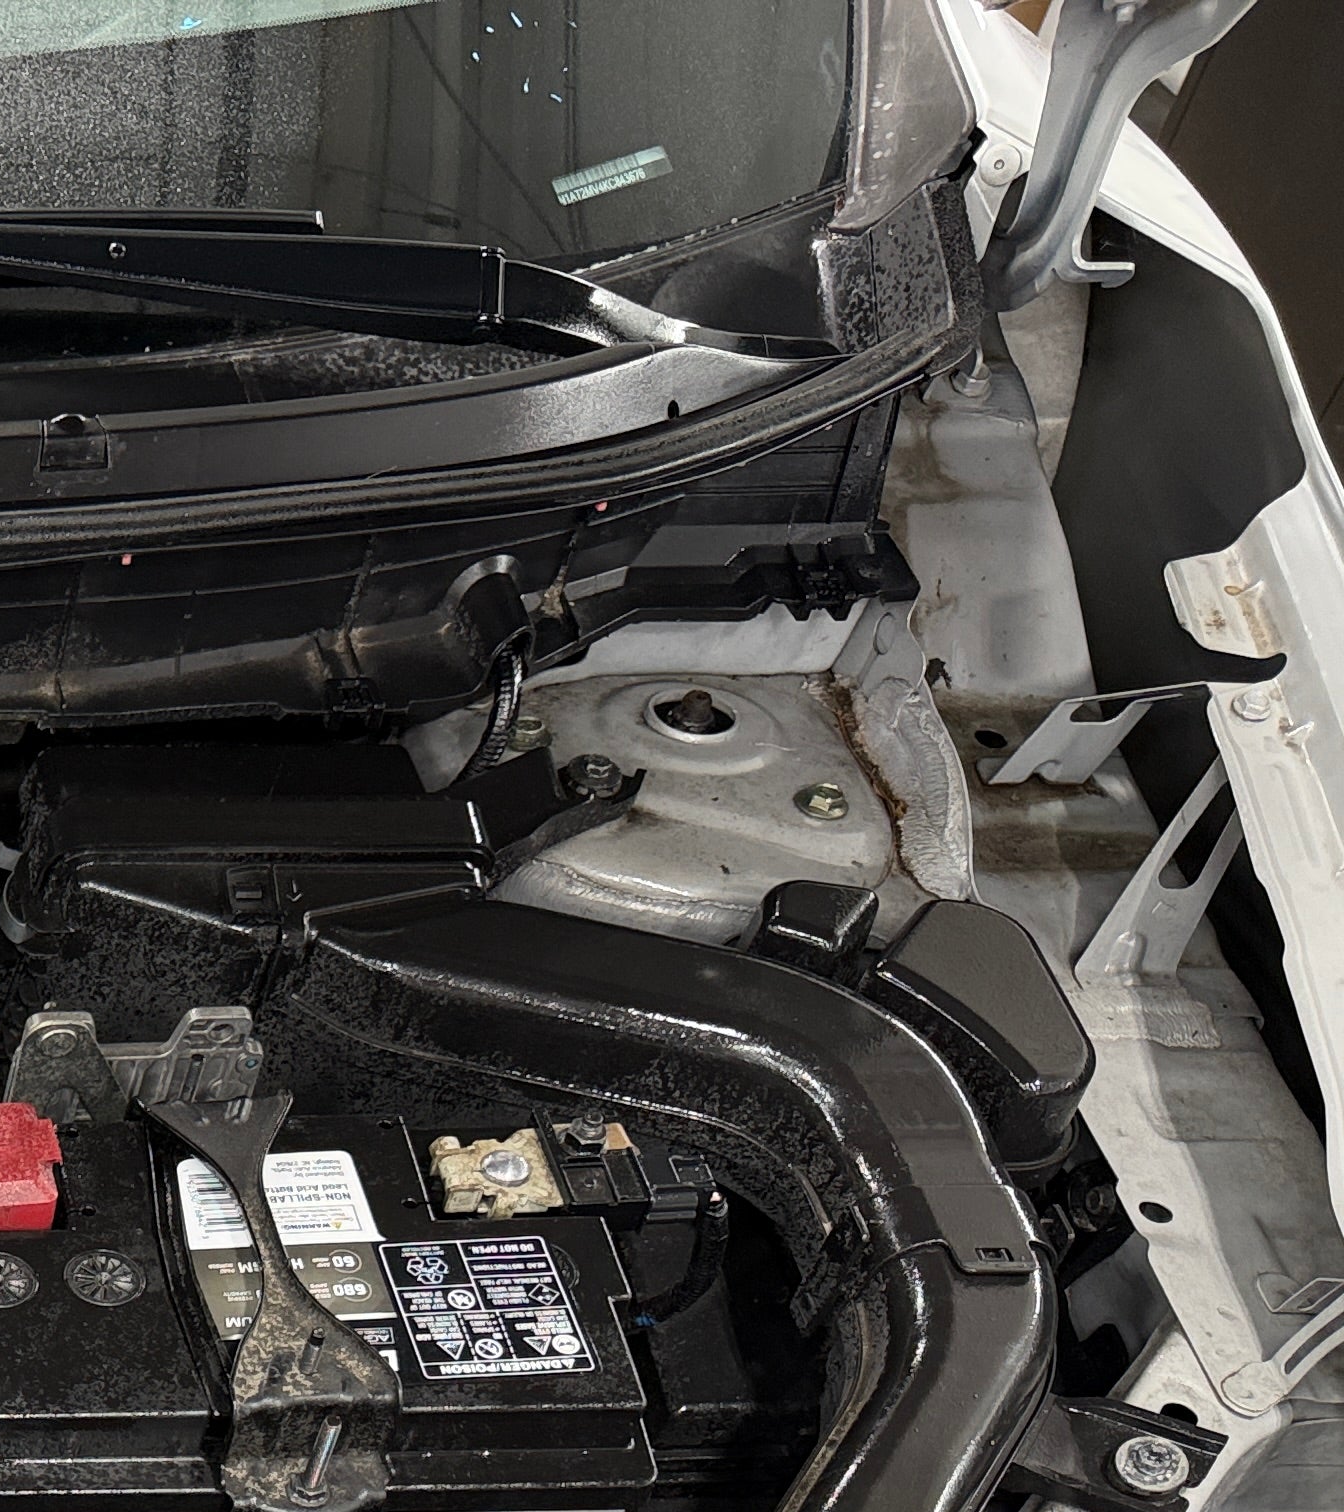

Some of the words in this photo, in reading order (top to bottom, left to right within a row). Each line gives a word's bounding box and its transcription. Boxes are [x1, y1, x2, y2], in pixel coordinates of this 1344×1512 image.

[296, 1185, 318, 1193] Acid
[322, 1183, 348, 1192] Lead
[499, 1243, 518, 1252] NOT
[520, 1242, 535, 1252] DO
[331, 1256, 356, 1269] 60
[332, 1283, 367, 1297] 680
[440, 1359, 563, 1375] DANGER/POISON
